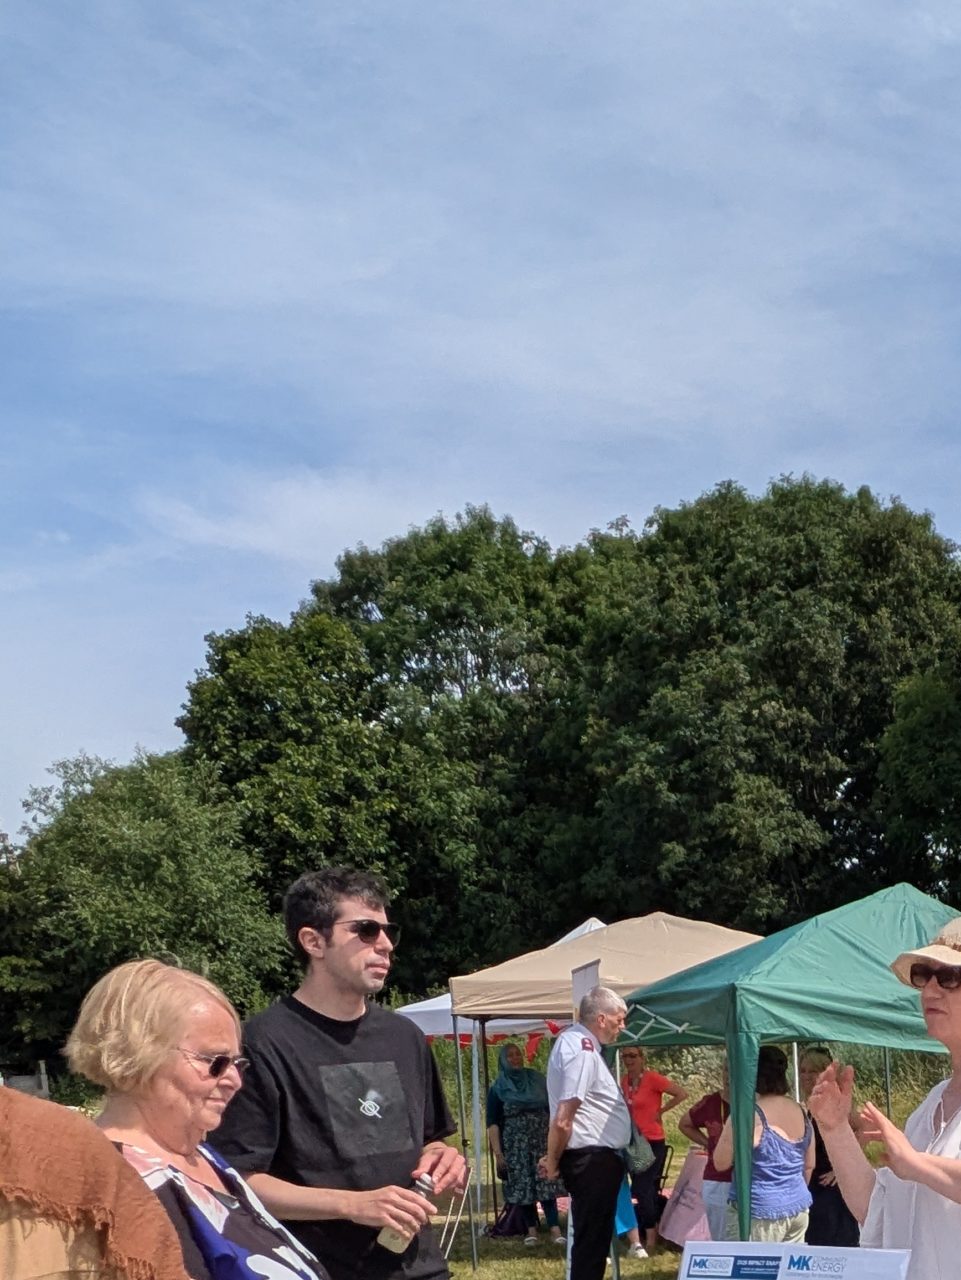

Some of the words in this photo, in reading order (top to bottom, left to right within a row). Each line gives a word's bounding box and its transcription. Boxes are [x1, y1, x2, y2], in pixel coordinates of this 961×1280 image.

[693, 1258, 708, 1269] MK
[787, 1254, 813, 1271] MK
[812, 1261, 846, 1273] ENERGY
